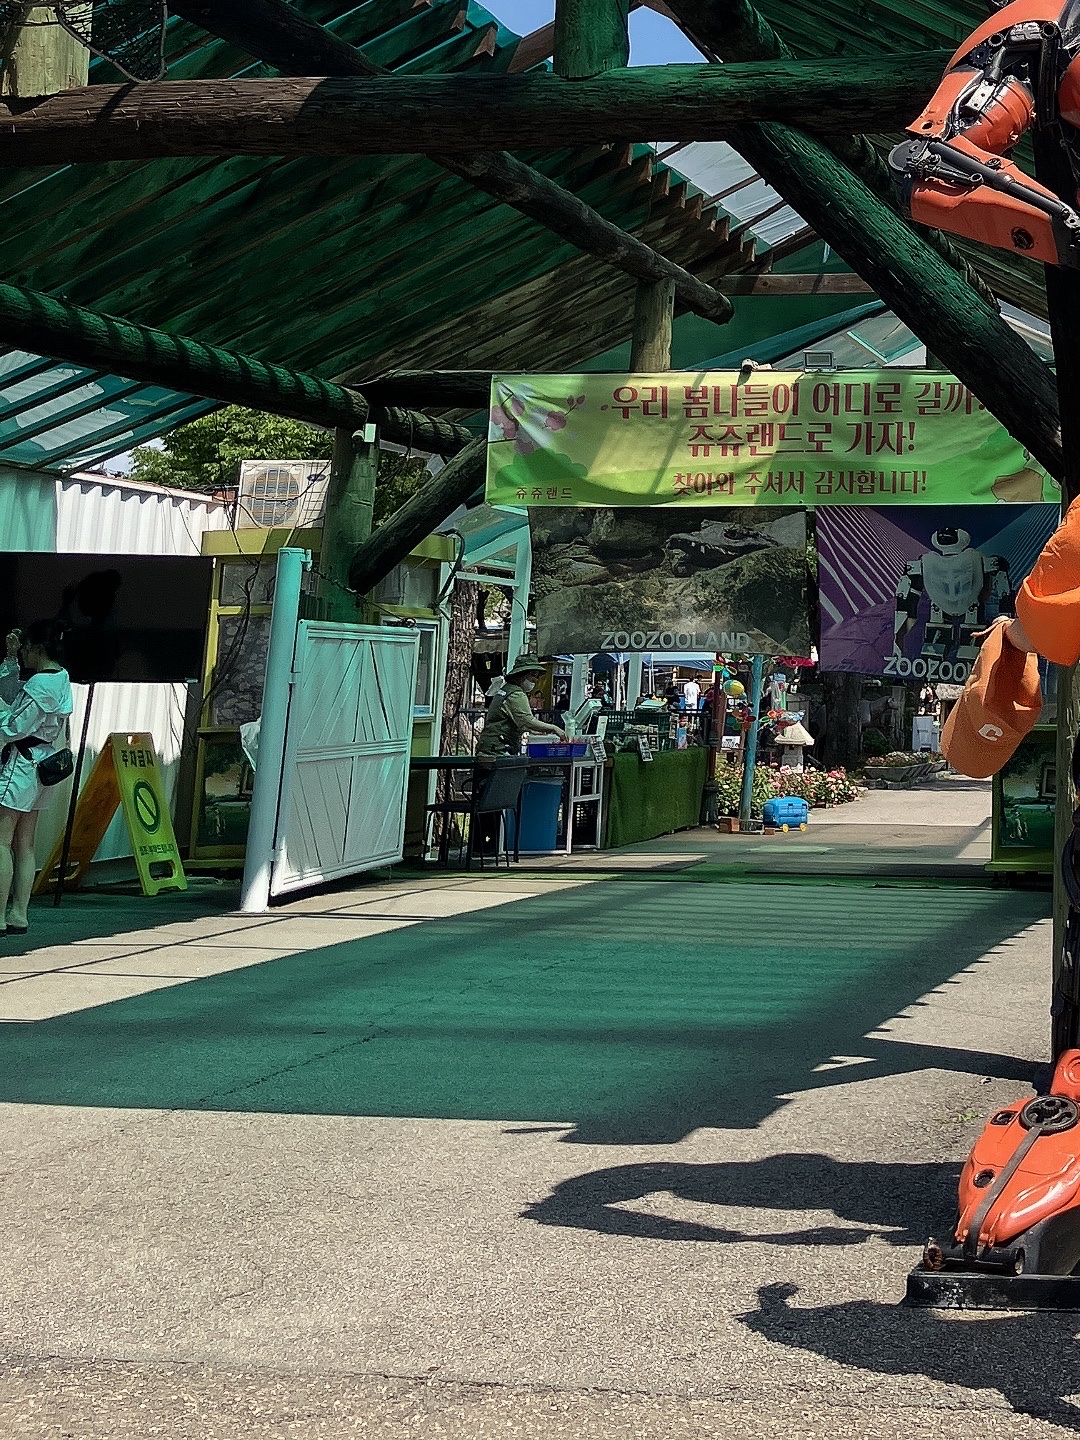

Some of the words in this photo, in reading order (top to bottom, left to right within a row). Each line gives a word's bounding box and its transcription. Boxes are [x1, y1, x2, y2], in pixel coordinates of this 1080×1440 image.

[611, 385, 668, 419] 우리
[682, 382, 800, 418] 봄나들이
[812, 382, 903, 416] 어디로
[914, 381, 986, 415] 갈까
[687, 422, 833, 457] 쥬쥬랜드로
[844, 421, 916, 456] 가자!
[515, 486, 573, 500] 쥬쥬랜드
[672, 471, 736, 496] 찾아와
[743, 470, 804, 495] 주셔서
[814, 470, 927, 495] 감사합니다!
[600, 631, 751, 650] ZOOZOOLAND
[121, 749, 154, 768] 주차금지
